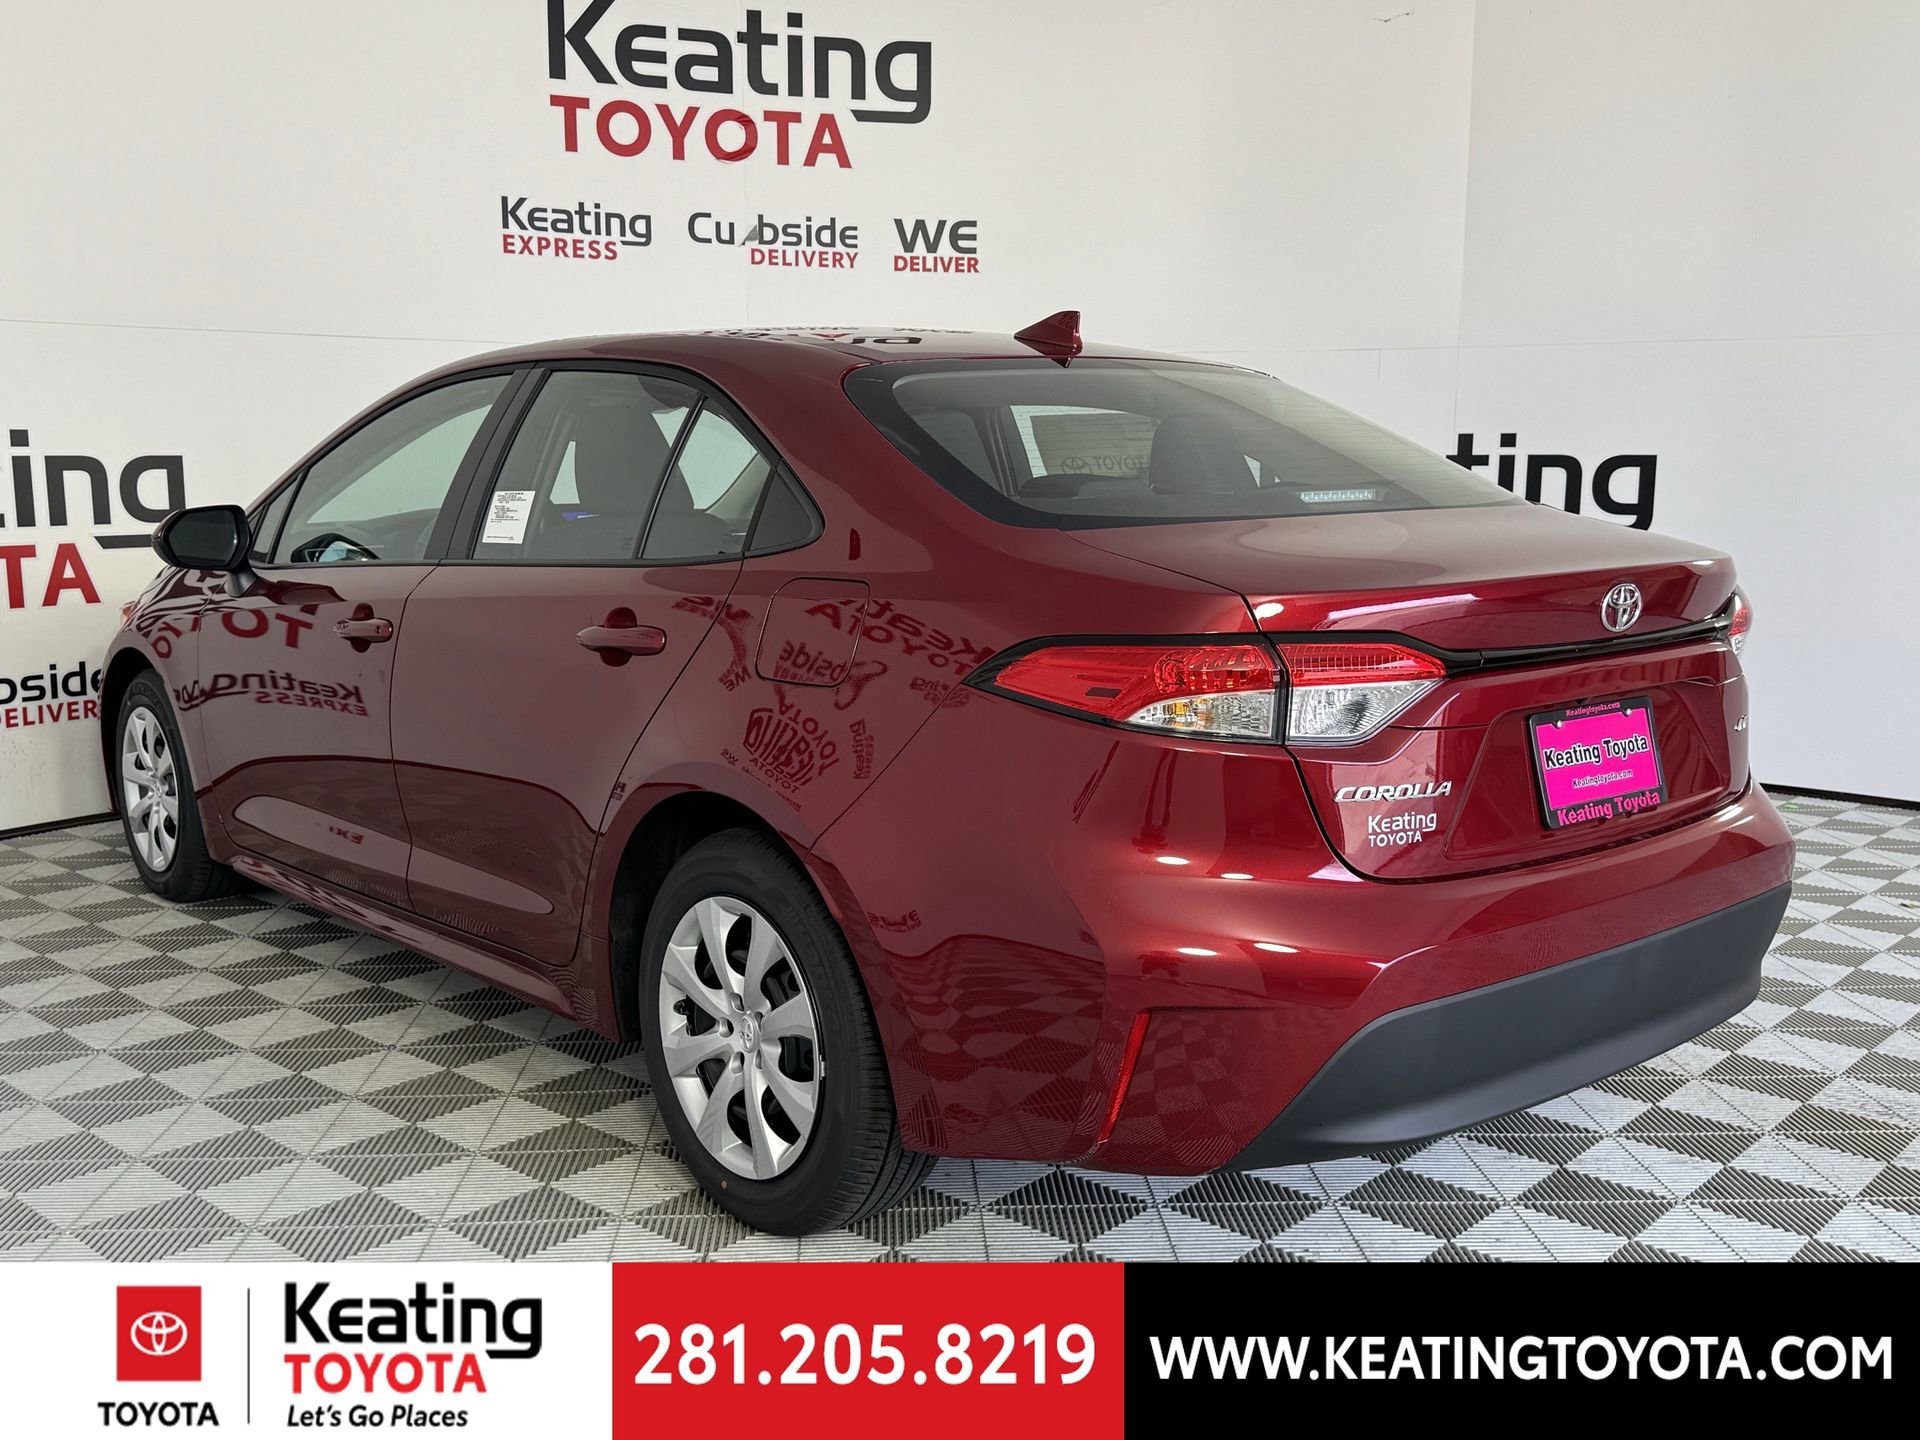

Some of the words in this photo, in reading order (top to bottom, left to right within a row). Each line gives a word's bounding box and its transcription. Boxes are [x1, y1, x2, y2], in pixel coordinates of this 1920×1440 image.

[547, 0, 932, 124] Keating
[549, 94, 853, 168] TOYOTA
[501, 195, 652, 247] Keating
[687, 212, 858, 249] Cubside
[893, 218, 978, 255] WE
[502, 234, 618, 260] EXPRESS
[750, 248, 858, 269] DELIVERY
[893, 255, 980, 273] DELIVER
[0, 429, 186, 549] ing
[0, 699, 100, 729] ELIVER
[1544, 743, 1601, 769] Keating
[1603, 735, 1648, 759] Toyota
[1333, 780, 1452, 803] COROLLA
[1557, 802, 1613, 826] Keating
[1615, 791, 1661, 813] Toyota
[1368, 811, 1437, 833] Keating
[1368, 830, 1422, 848] TOYOTA
